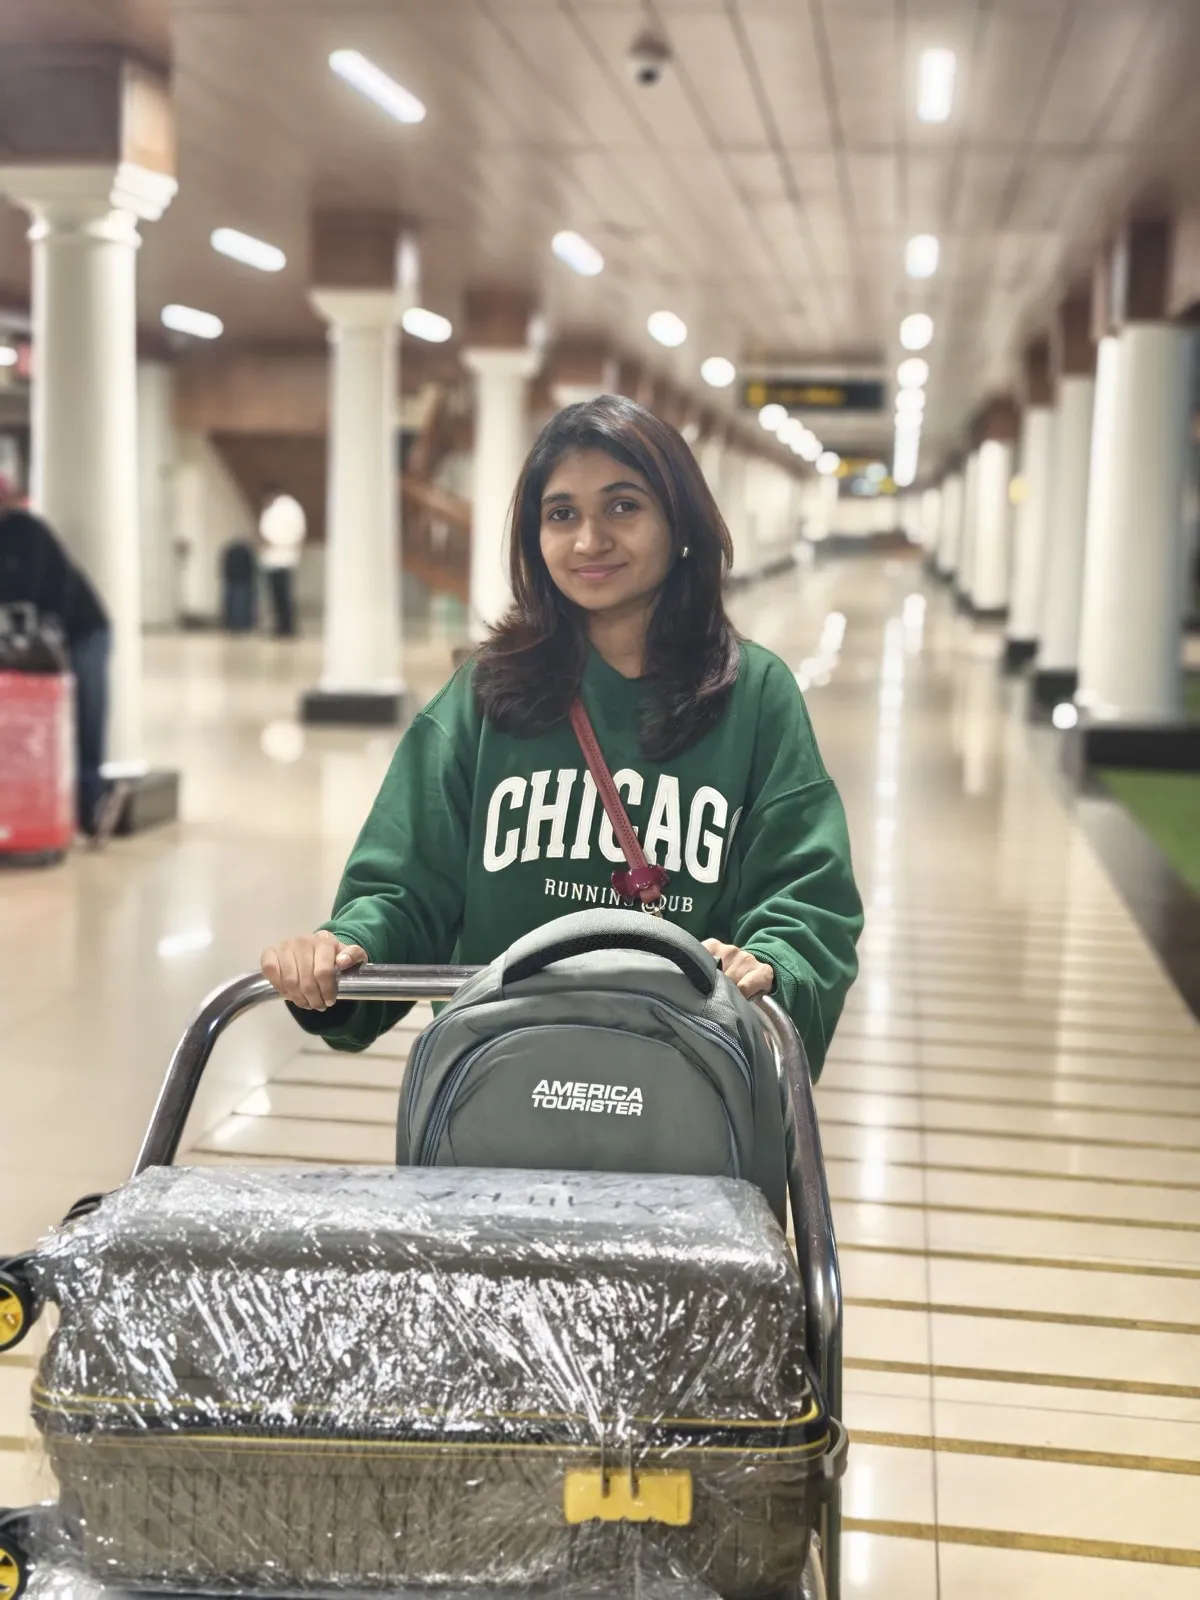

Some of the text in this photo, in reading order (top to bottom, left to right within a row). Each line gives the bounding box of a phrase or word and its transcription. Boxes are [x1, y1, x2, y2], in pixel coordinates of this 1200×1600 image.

[483, 768, 743, 883] CHICAG
[544, 878, 634, 907] RUNNIN
[532, 1079, 644, 1103] AMERICA
[531, 1094, 644, 1117] TOURISTER
